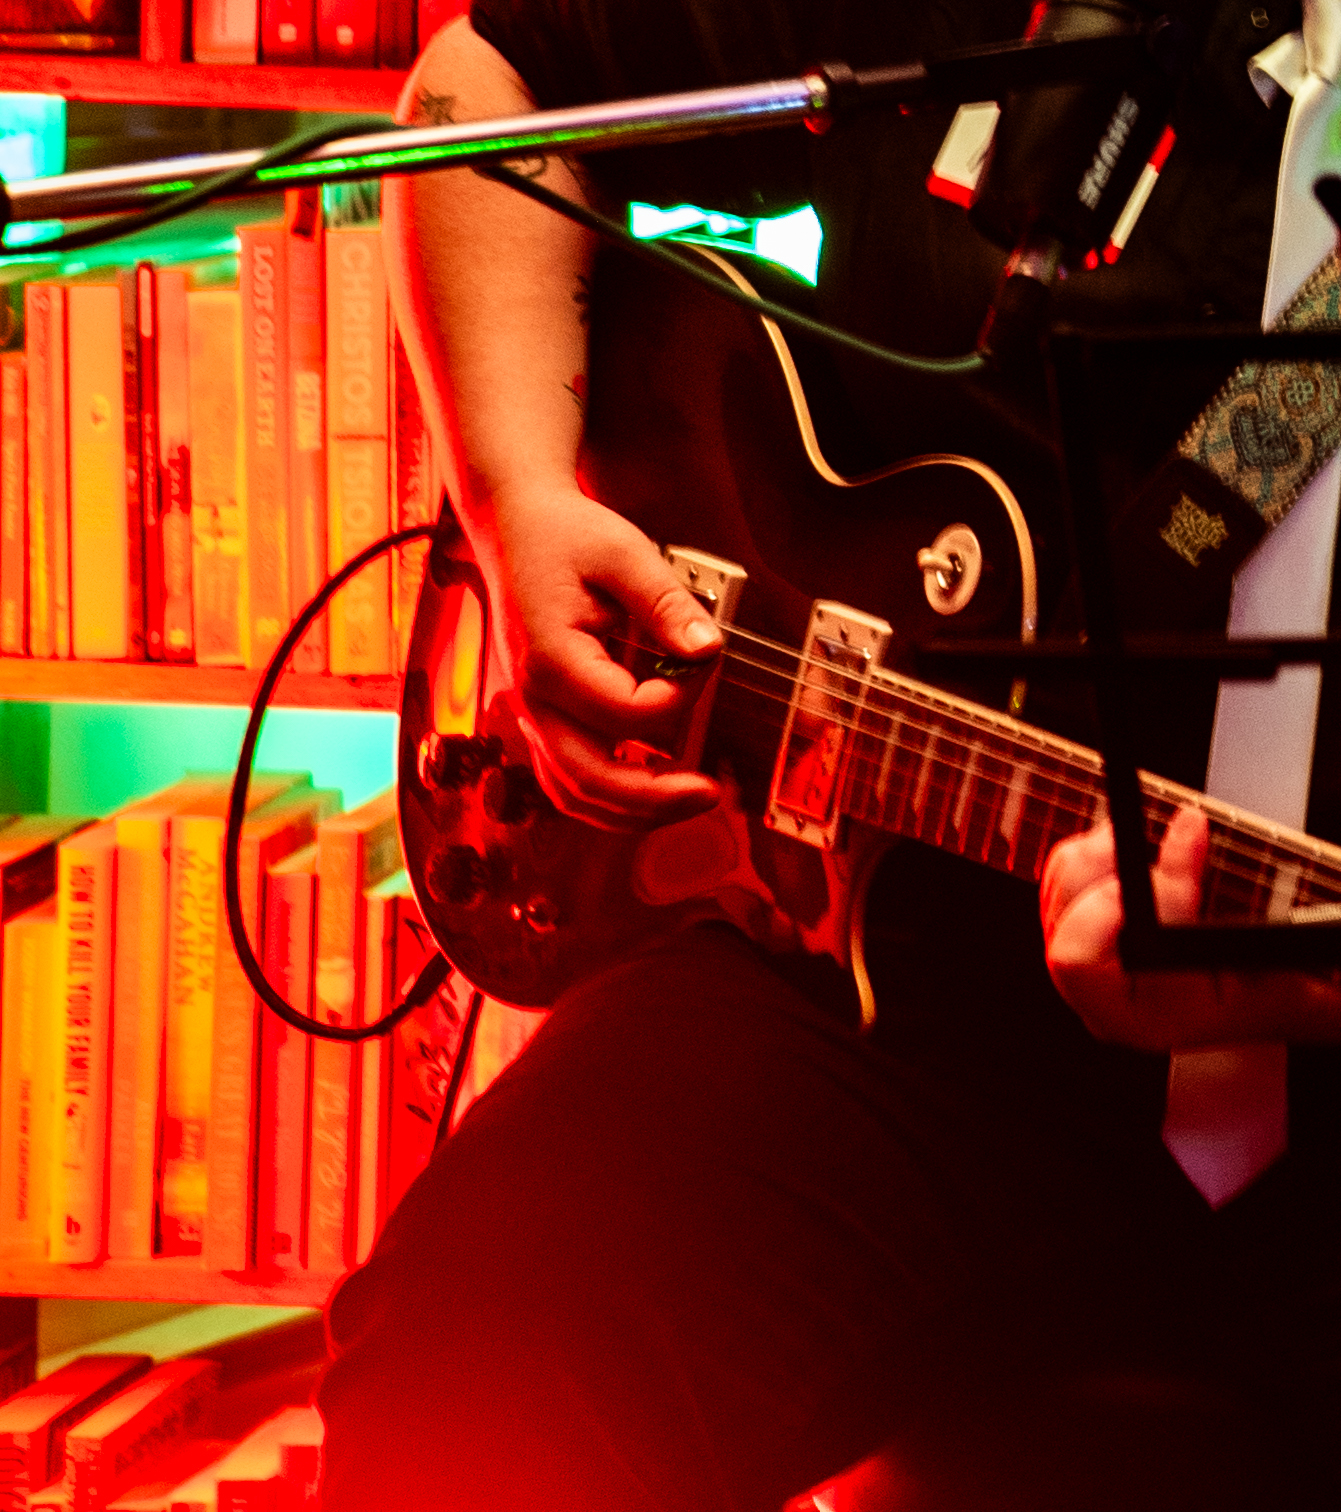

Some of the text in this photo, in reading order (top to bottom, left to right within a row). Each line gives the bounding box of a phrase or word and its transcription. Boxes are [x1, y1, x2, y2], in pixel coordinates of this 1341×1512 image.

[1075, 90, 1141, 212] SHURE
[254, 244, 276, 448] LOST ON EARTH
[340, 239, 376, 625] CHRISTOS TSIOLAS
[65, 864, 96, 1098] HOW TO KILL YOUR FAMILY
[172, 846, 198, 1007] McGAHAN
[198, 859, 218, 994] ANDREW
